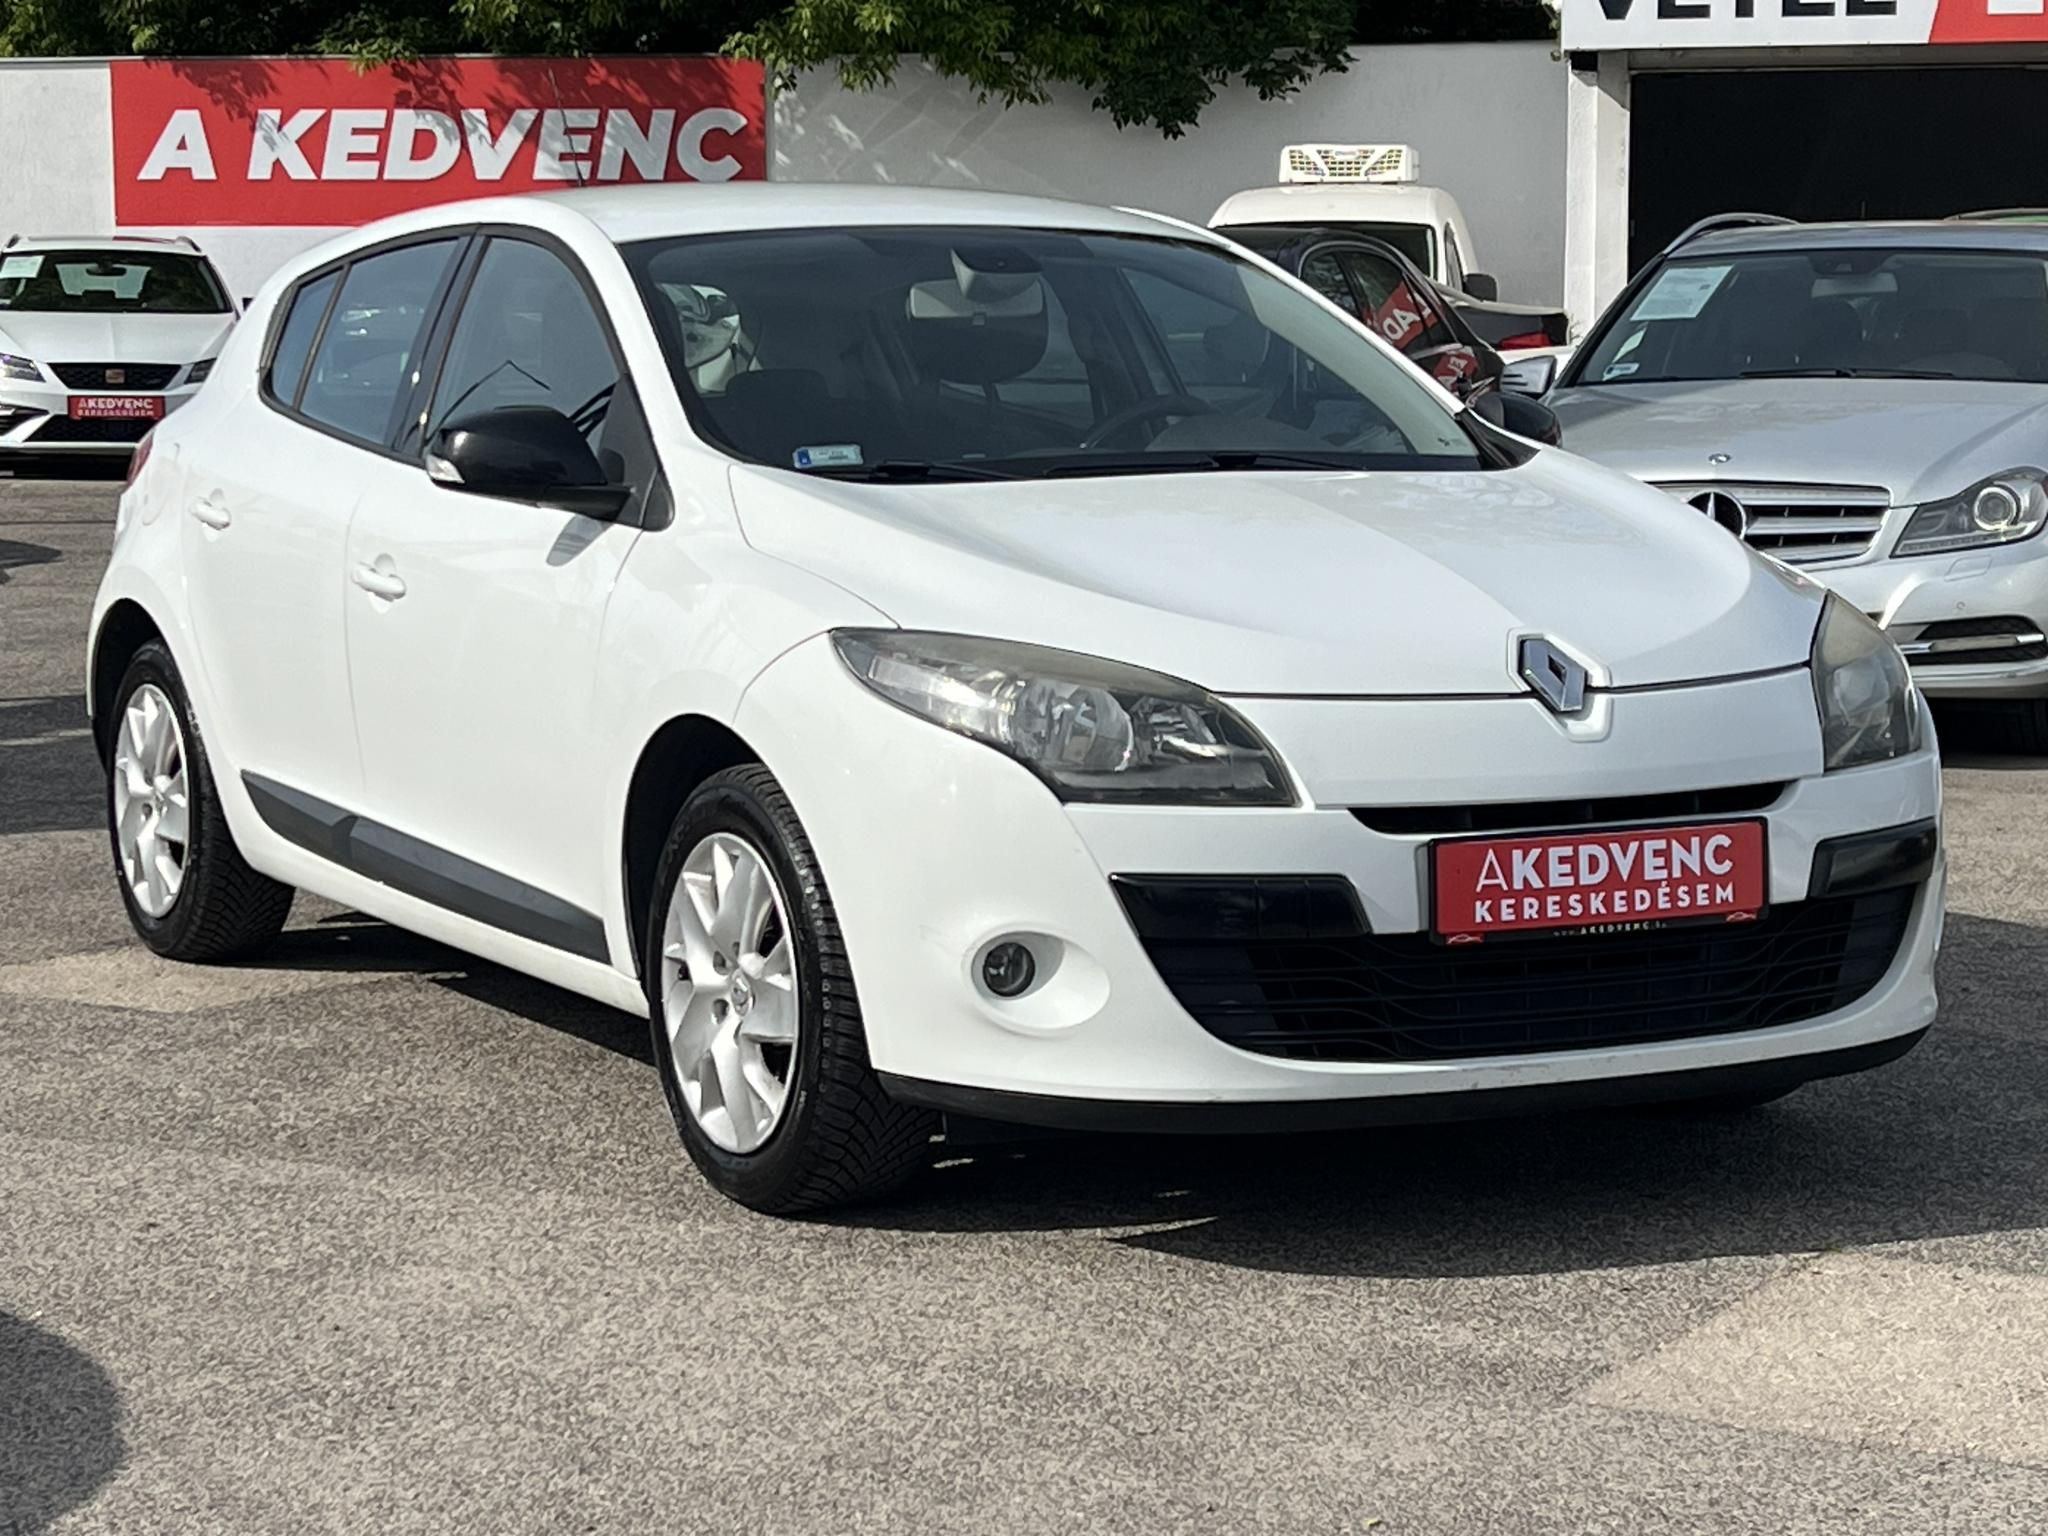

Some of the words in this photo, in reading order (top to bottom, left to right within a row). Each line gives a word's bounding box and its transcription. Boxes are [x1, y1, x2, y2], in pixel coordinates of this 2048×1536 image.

[137, 109, 217, 181] A
[247, 109, 748, 183] KEDVENC
[78, 398, 153, 409] AKEDVENC
[1475, 880, 1734, 923] KERESKEDÉSEM
